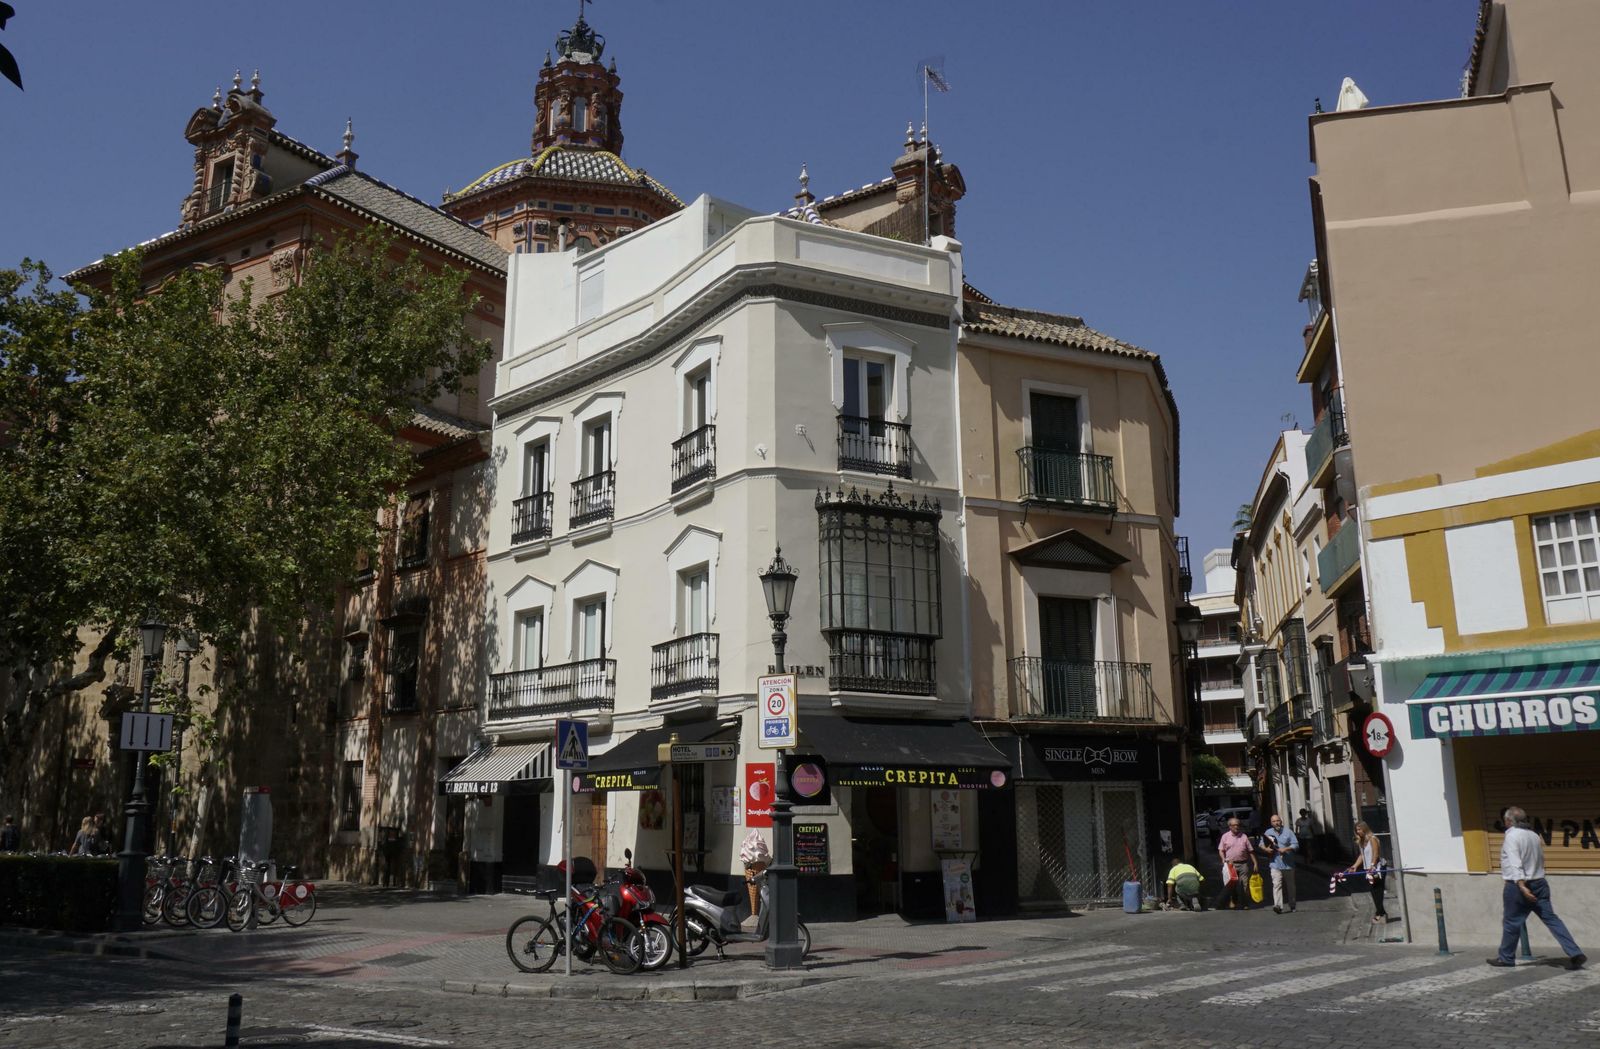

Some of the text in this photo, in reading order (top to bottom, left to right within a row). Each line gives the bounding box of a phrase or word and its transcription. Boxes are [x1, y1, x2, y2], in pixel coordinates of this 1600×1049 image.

[768, 665, 825, 677] BILEN
[763, 678, 792, 686] ATENCIÓN
[771, 700, 782, 708] 20
[1428, 695, 1598, 733] CHURROS
[1044, 749, 1137, 761] SINGLE BOW
[885, 769, 958, 785] CREPITA
[1090, 767, 1105, 775] MEN
[445, 782, 498, 793] TABERNA el 13
[595, 775, 632, 788] CREPITA
[1560, 815, 1600, 850] PA
